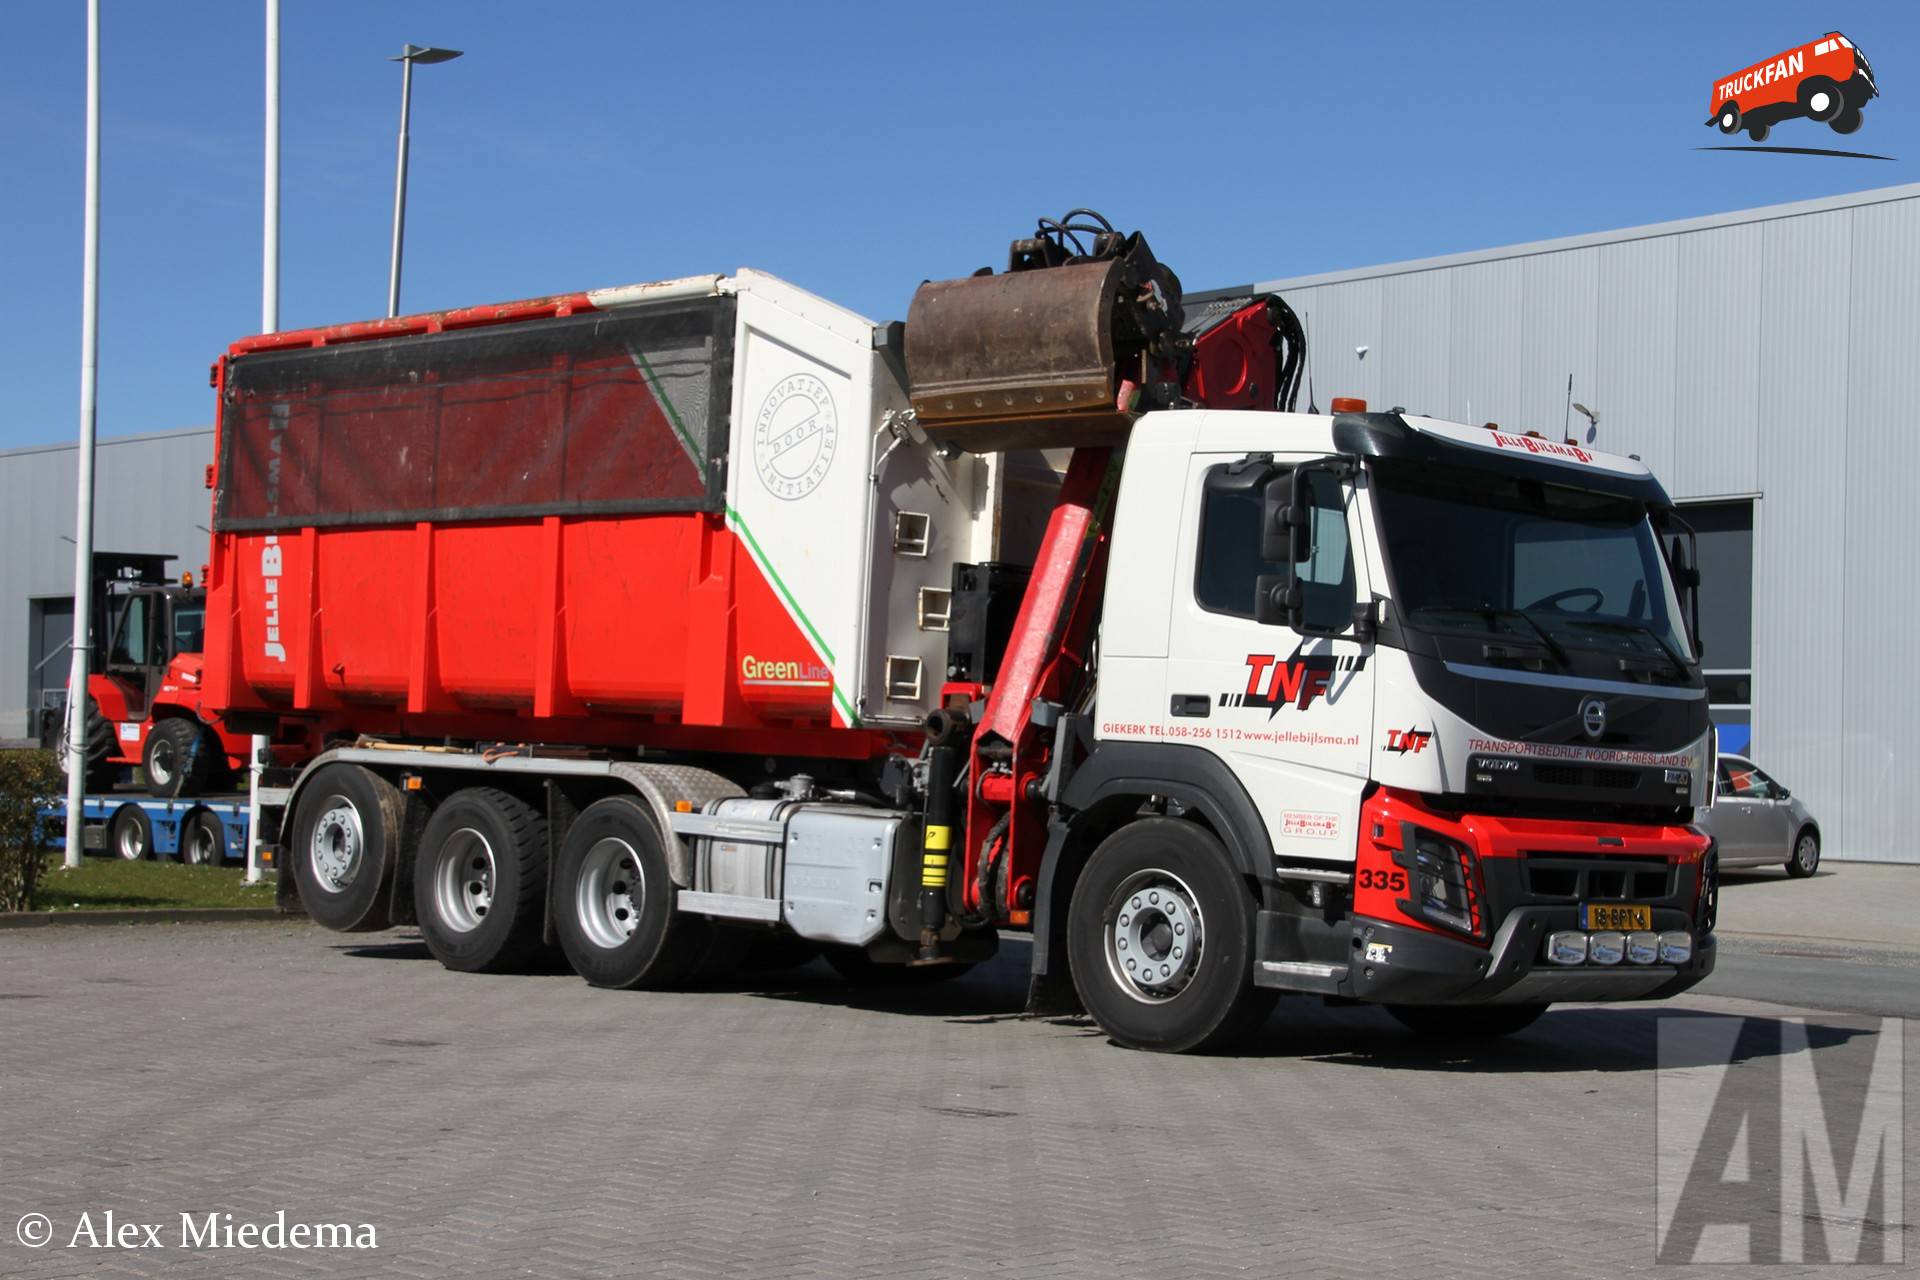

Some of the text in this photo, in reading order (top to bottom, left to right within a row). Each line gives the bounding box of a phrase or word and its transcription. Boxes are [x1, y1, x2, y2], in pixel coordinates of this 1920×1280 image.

[757, 378, 830, 446] INNOVATIEF
[772, 419, 817, 455] DOOR
[761, 423, 835, 496] INITIATIEF
[1246, 654, 1333, 711] TNF
[1102, 723, 1146, 736] GIEKERK
[1216, 729, 1242, 740] 1512
[1244, 730, 1360, 746] www.jellebijlsma.nl
[1387, 729, 1430, 754] TNF
[1468, 739, 1693, 768] TRANSPORTBEDRIJF NOORD-FRIESLAND BV
[1475, 758, 1520, 771] VOLVO
[1283, 827, 1338, 836] GROUP
[1359, 868, 1405, 892] 335
